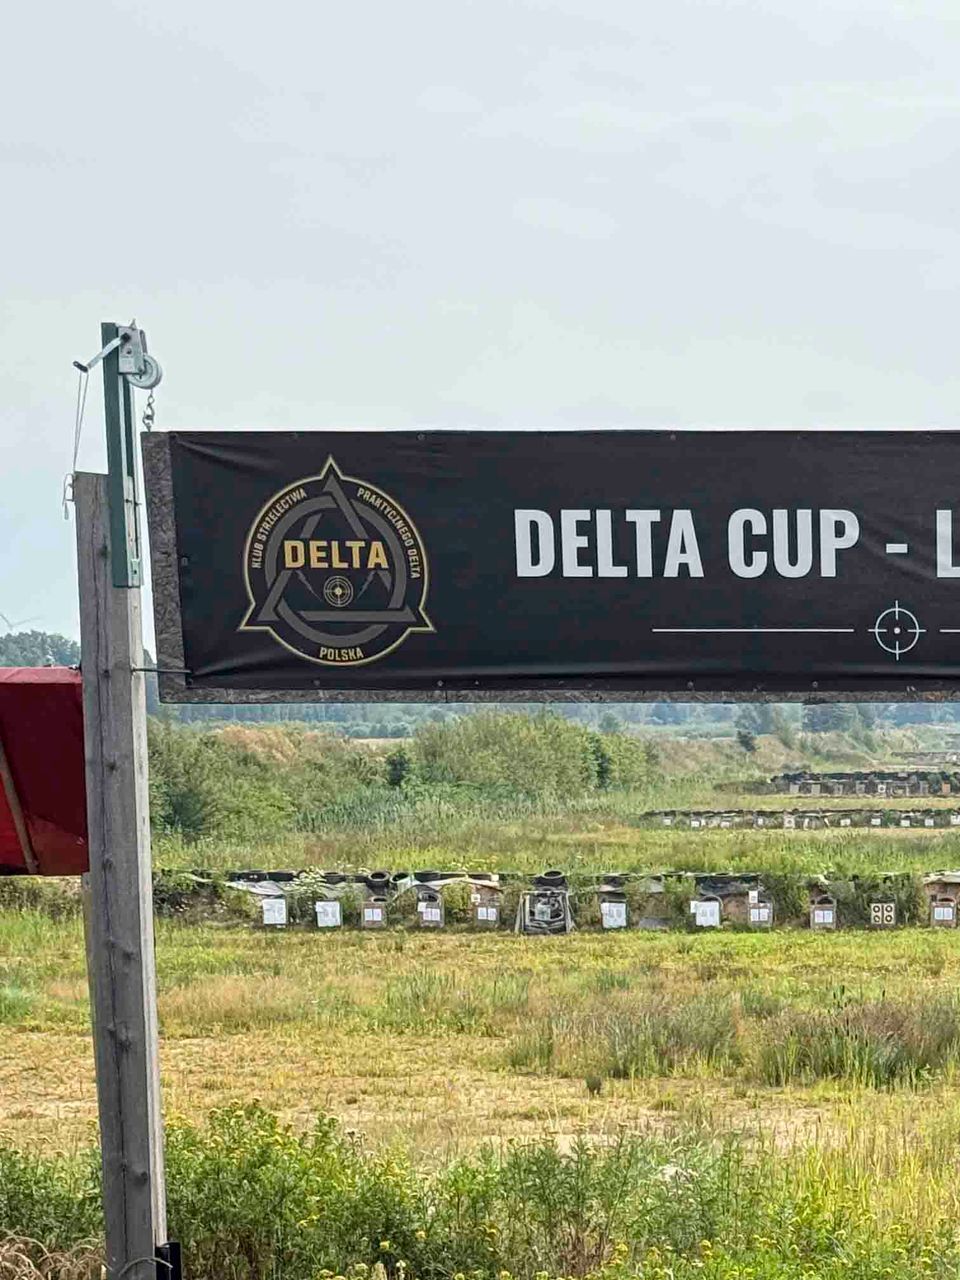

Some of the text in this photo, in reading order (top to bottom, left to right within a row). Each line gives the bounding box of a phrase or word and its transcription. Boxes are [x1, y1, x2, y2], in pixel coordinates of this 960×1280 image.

[251, 487, 421, 579] KLUB STRZELECTWA PRAKTYCZNEGO DELTA
[283, 540, 389, 569] DELTA
[514, 508, 704, 578] DELTA
[727, 508, 861, 578] CUP
[886, 544, 908, 554] -
[319, 646, 364, 661] POLSKA
